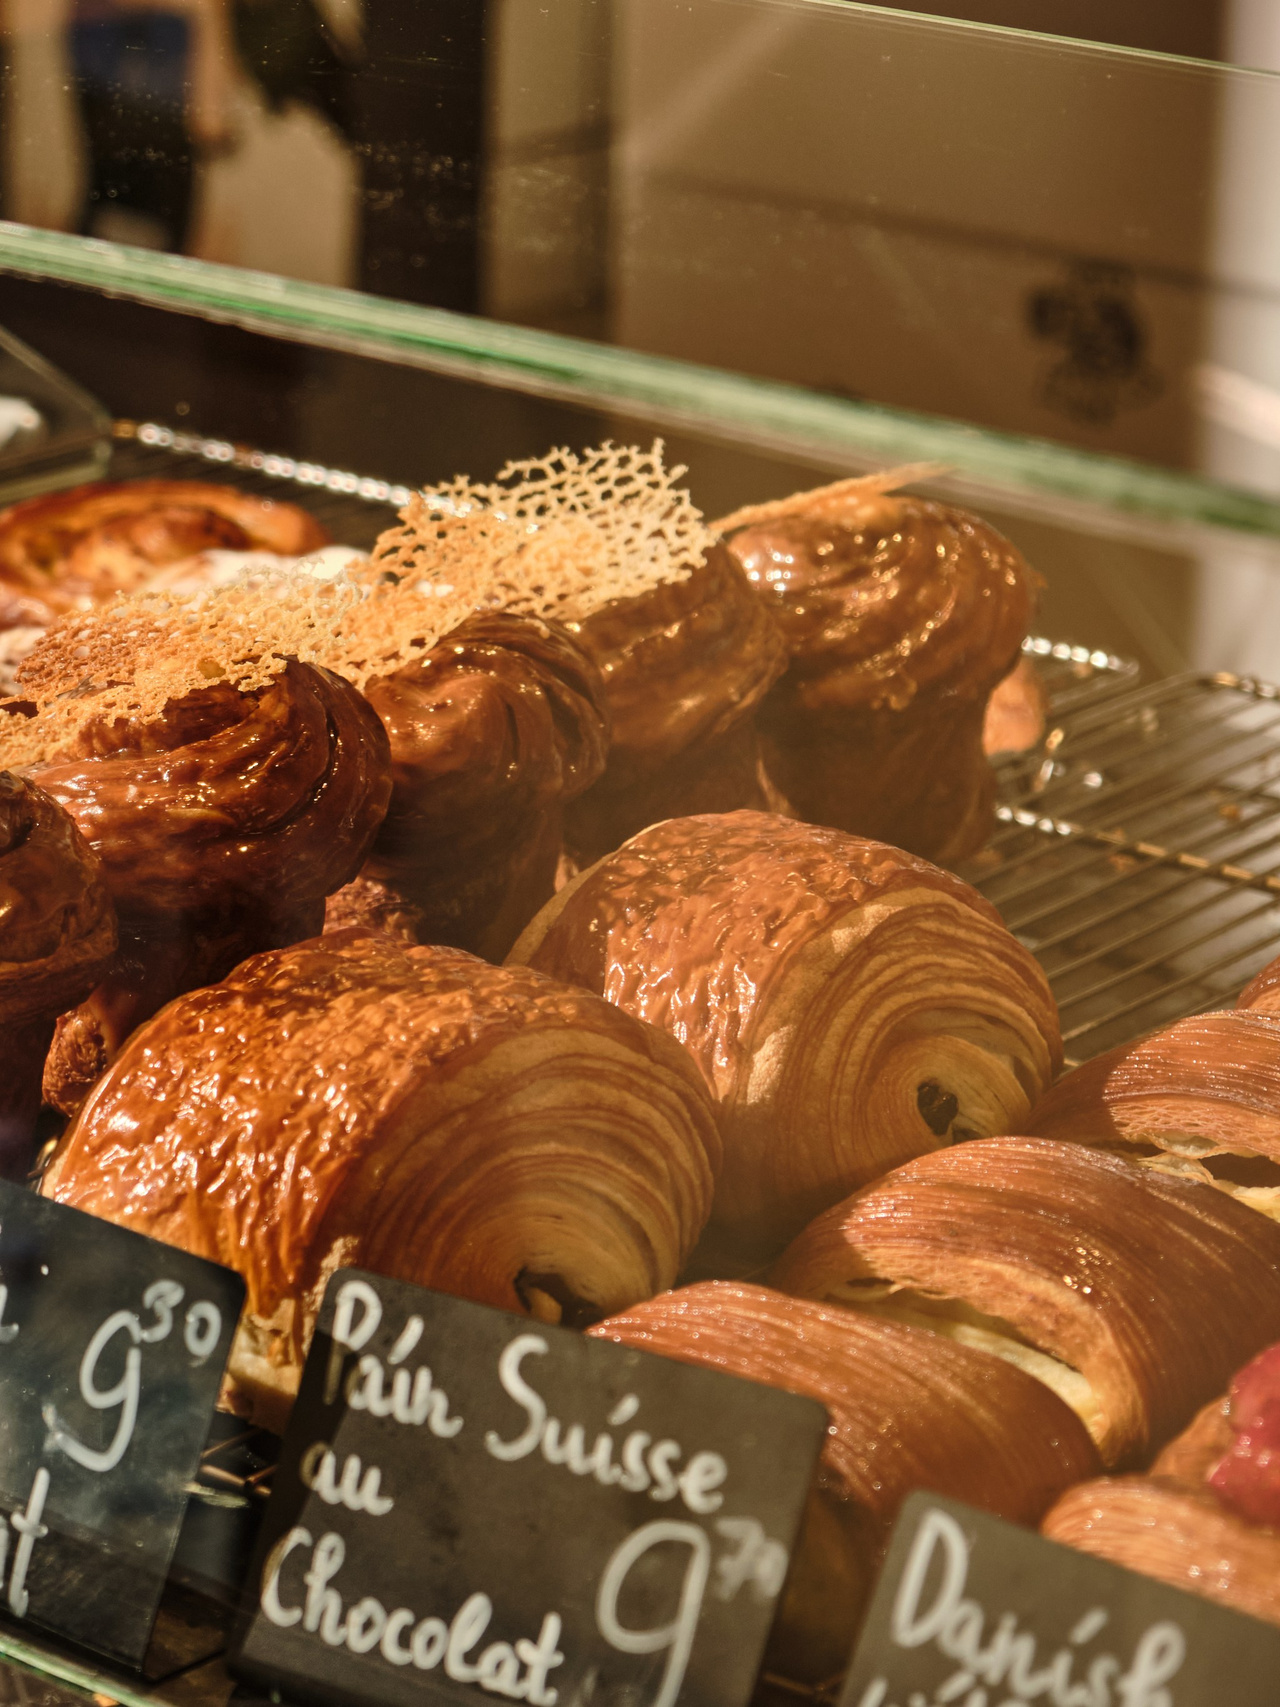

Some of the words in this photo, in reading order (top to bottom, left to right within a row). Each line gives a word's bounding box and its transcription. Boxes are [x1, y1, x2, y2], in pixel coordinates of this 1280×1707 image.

[43, 1310, 142, 1472] 9
[141, 1279, 221, 1358] 30
[301, 1441, 394, 1515] au
[485, 1333, 728, 1512] Suisse
[260, 1526, 564, 1706] Chocolat
[596, 1518, 710, 1707] 9
